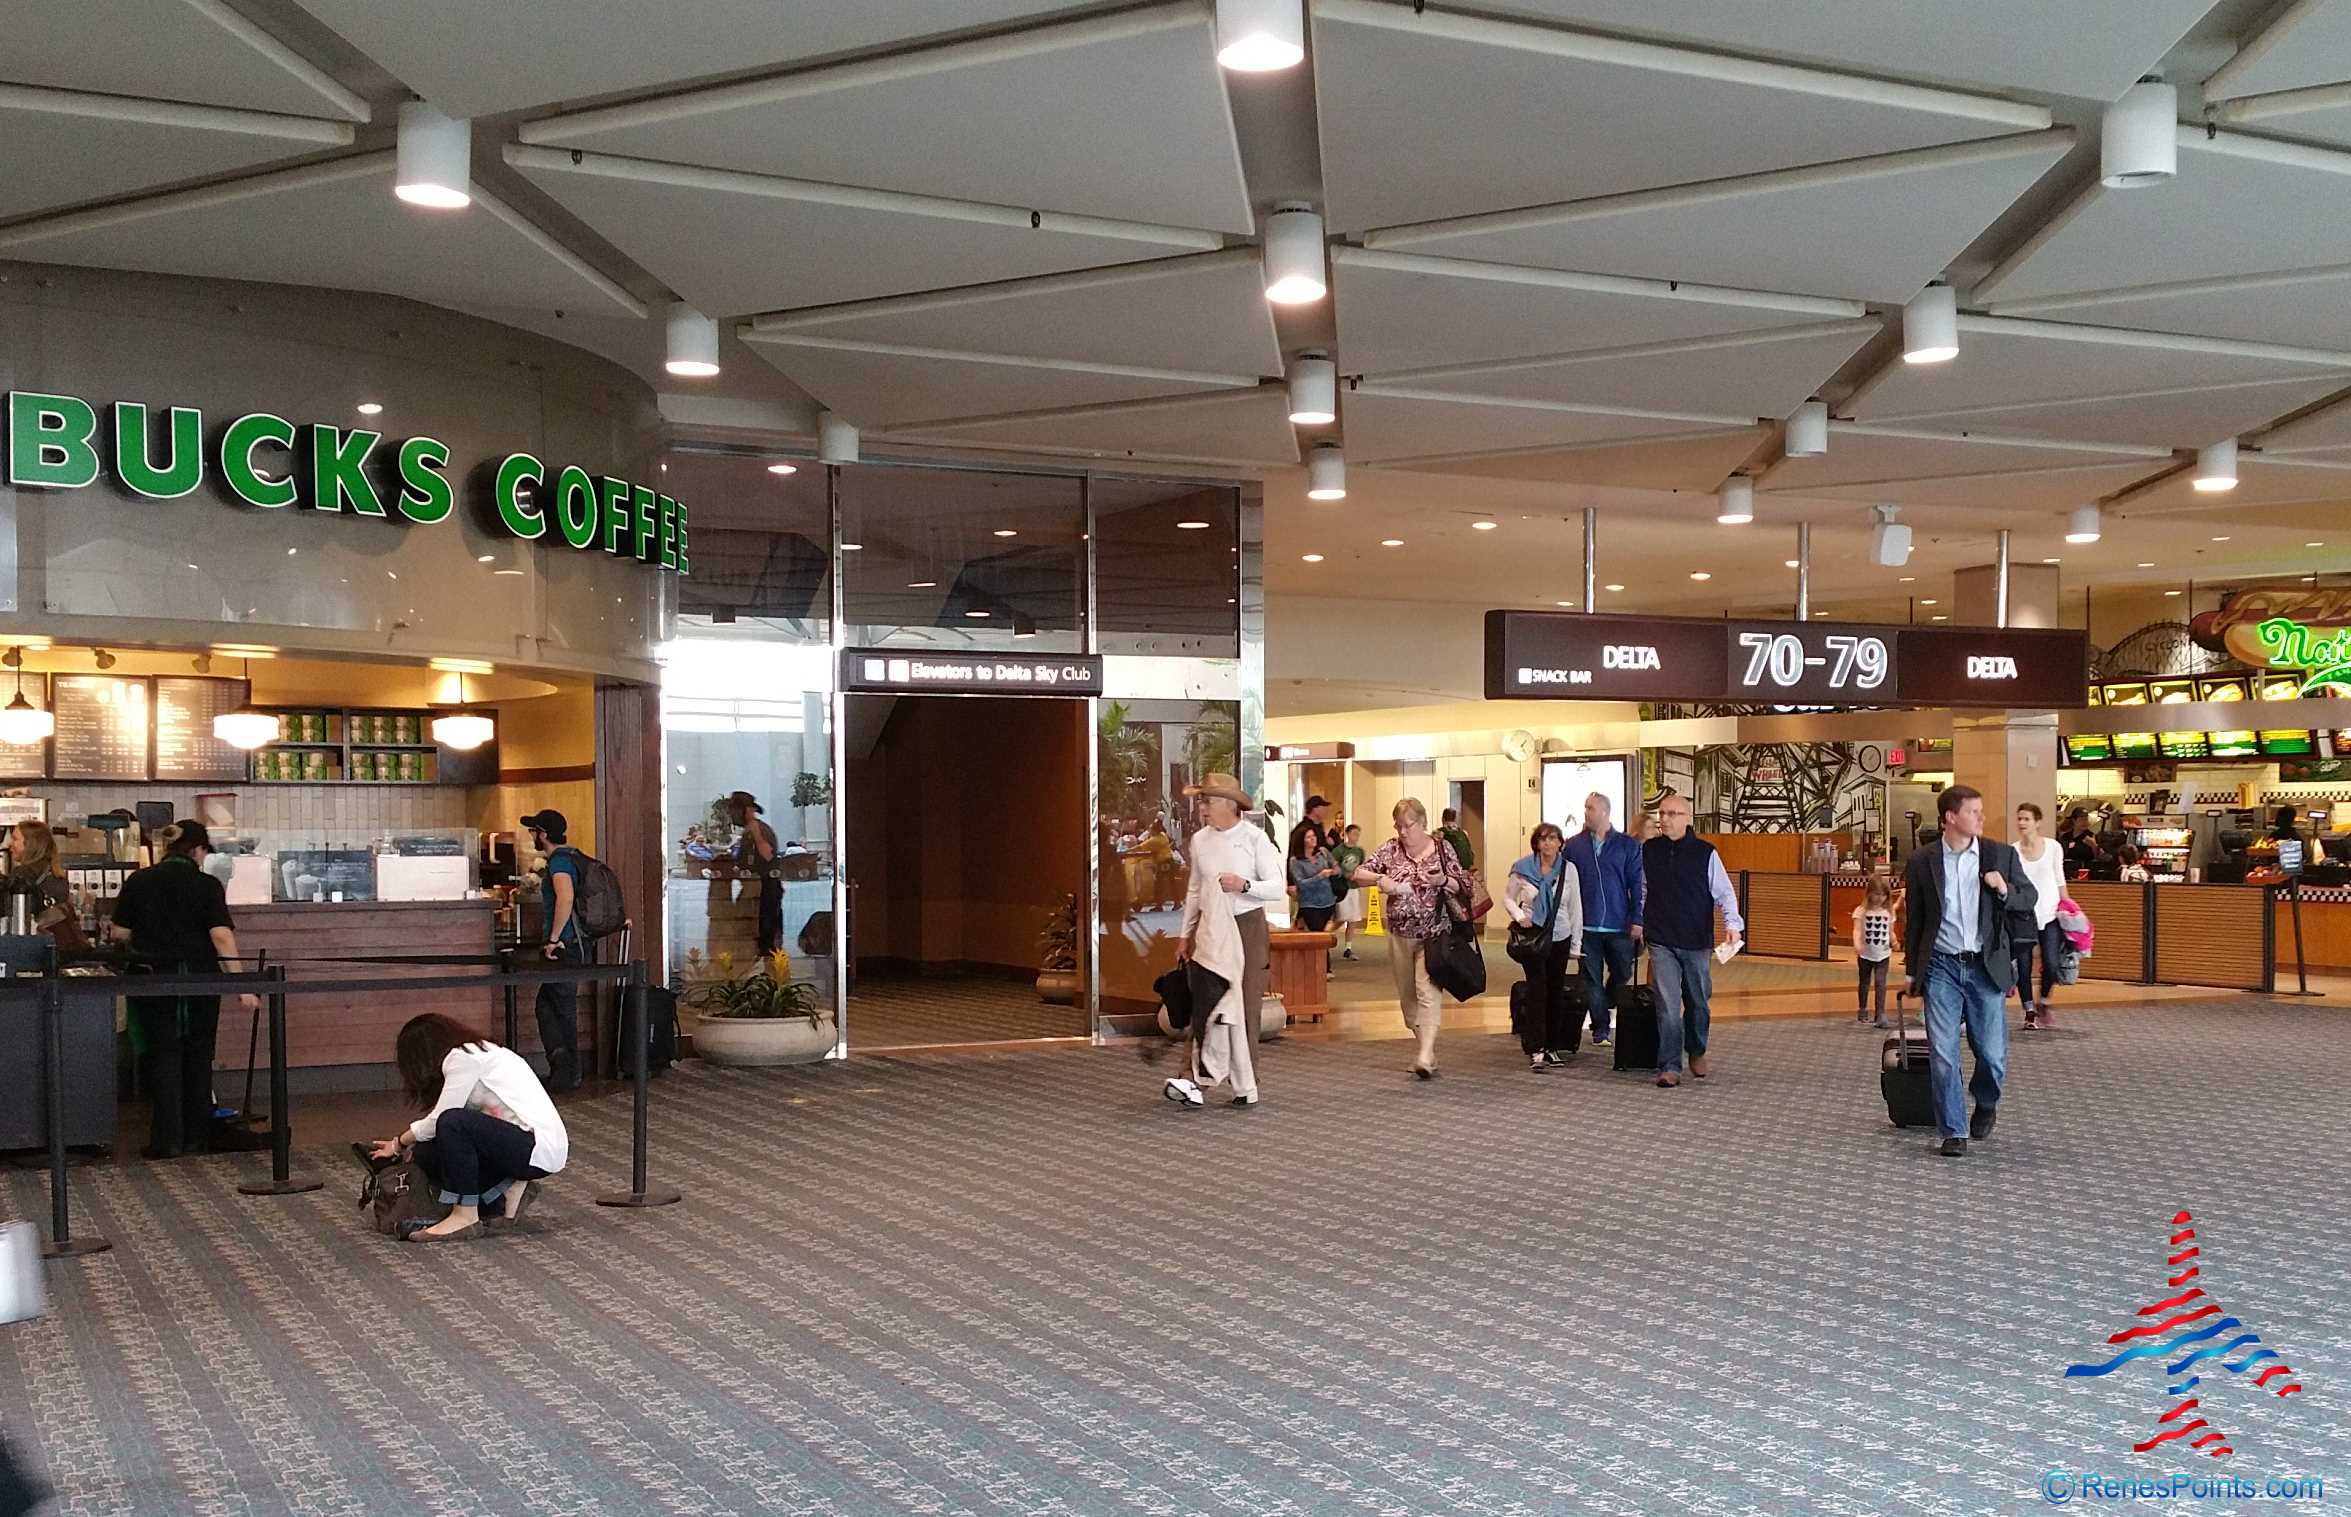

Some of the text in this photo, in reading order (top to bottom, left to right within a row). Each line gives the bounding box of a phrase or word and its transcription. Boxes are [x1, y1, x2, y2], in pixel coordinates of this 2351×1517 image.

[9, 389, 689, 576] BUCKS COFFEE
[1602, 645, 1662, 671] DELTA
[1739, 632, 1888, 689] 70-79
[1966, 656, 2018, 680] DELTA
[911, 661, 1091, 684] Elevators to Delta Sky Club
[1531, 669, 1592, 684] SNACK BAR
